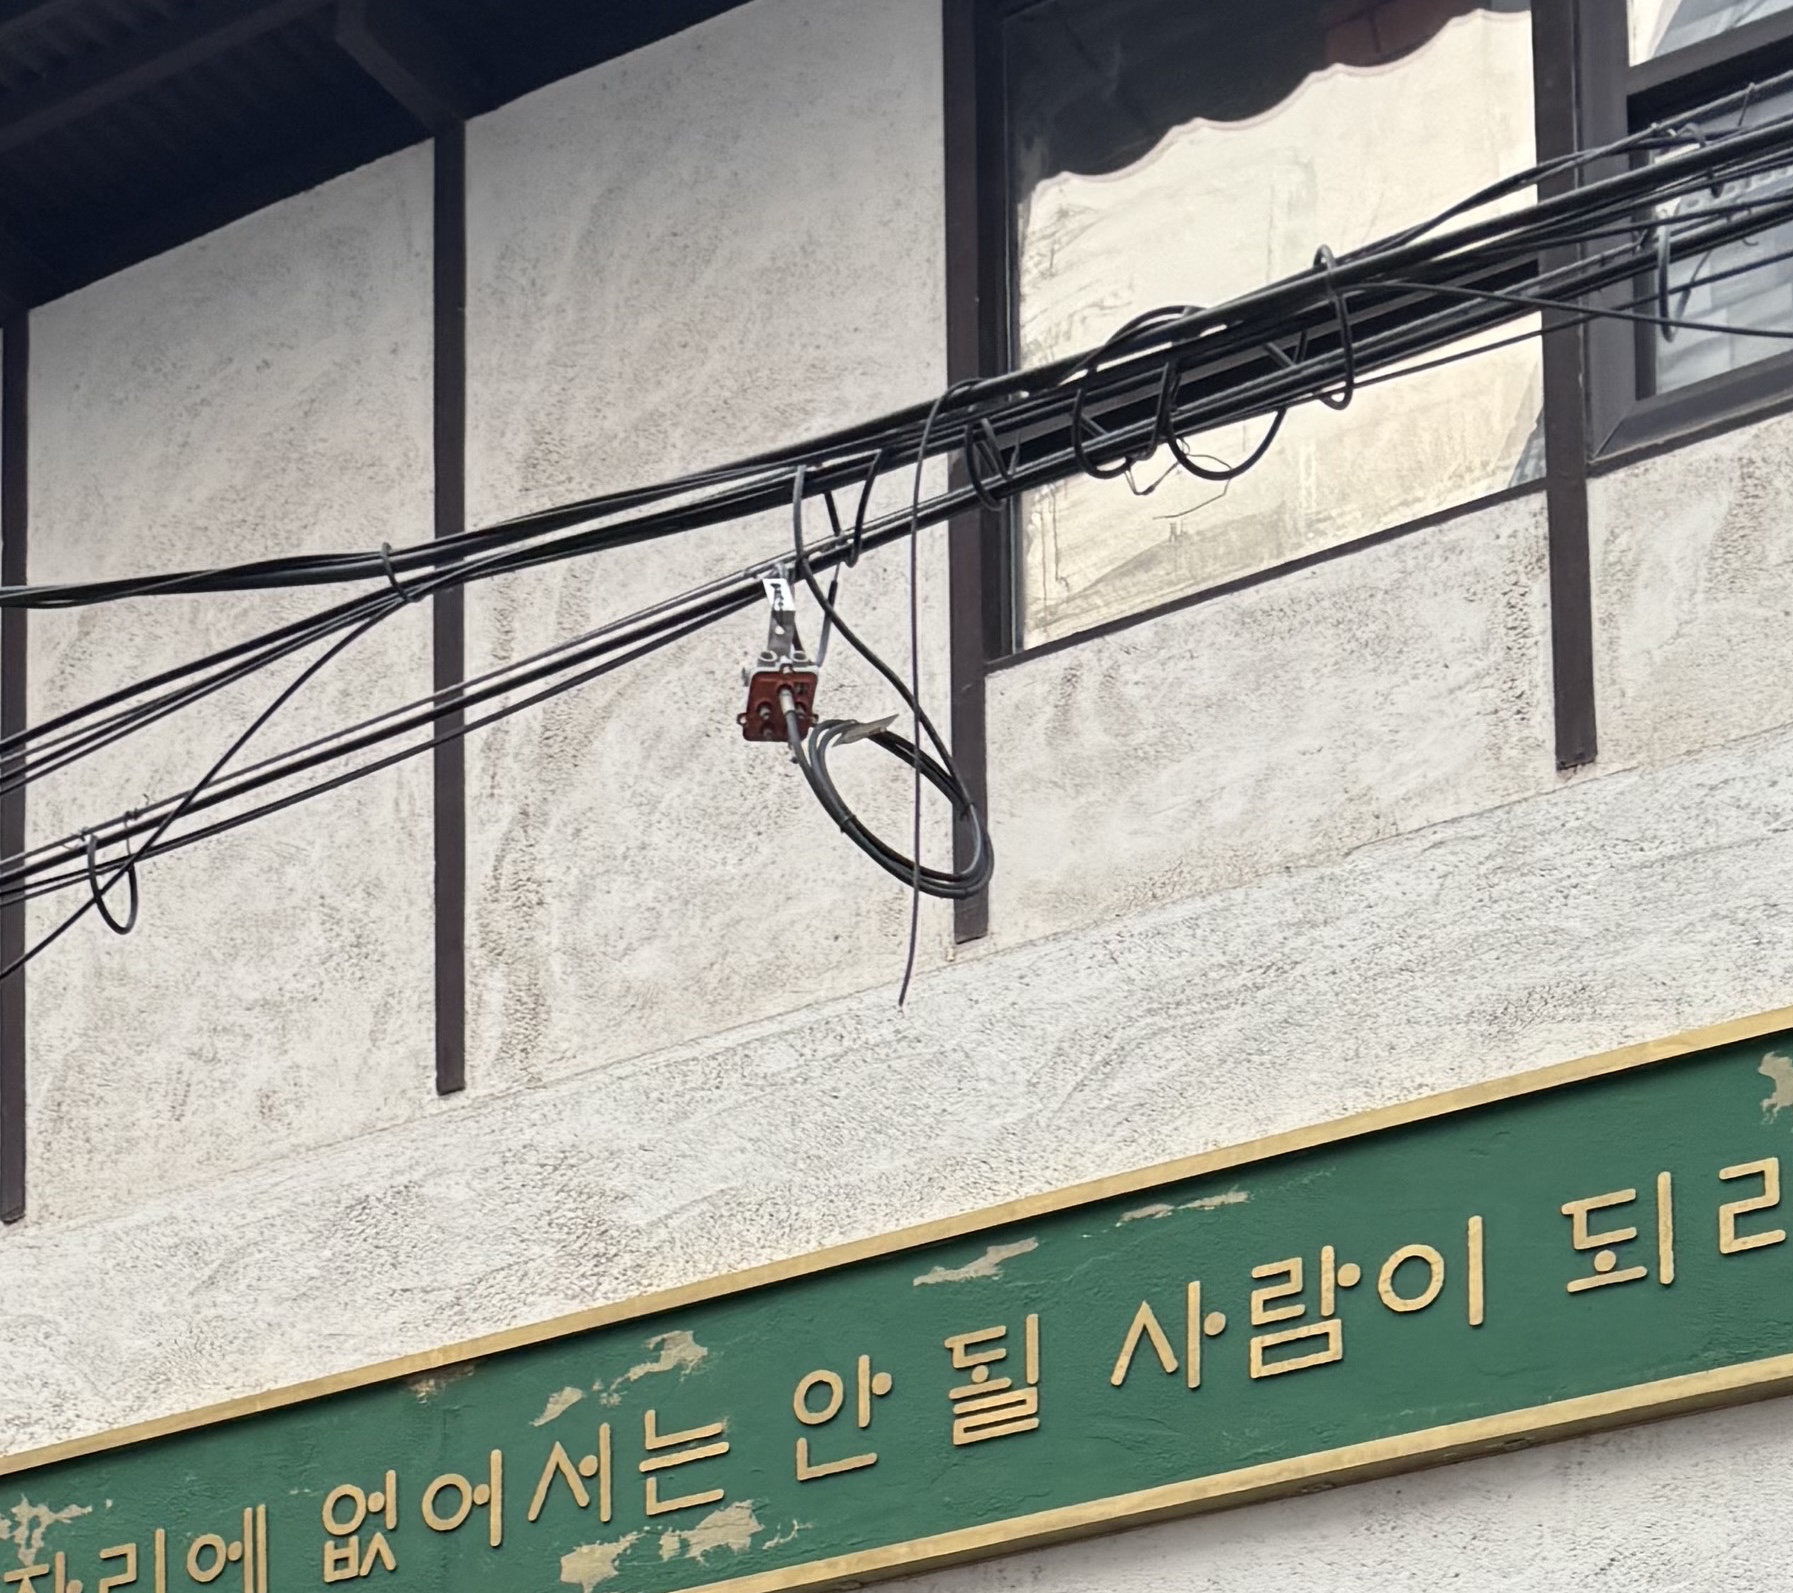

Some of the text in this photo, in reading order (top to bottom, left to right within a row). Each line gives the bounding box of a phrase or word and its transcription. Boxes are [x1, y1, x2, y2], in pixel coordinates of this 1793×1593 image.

[322, 1409, 730, 1583] 없어서는
[793, 1355, 892, 1481] 안
[944, 1314, 1040, 1446] 될
[1110, 1216, 1484, 1388] 사람이
